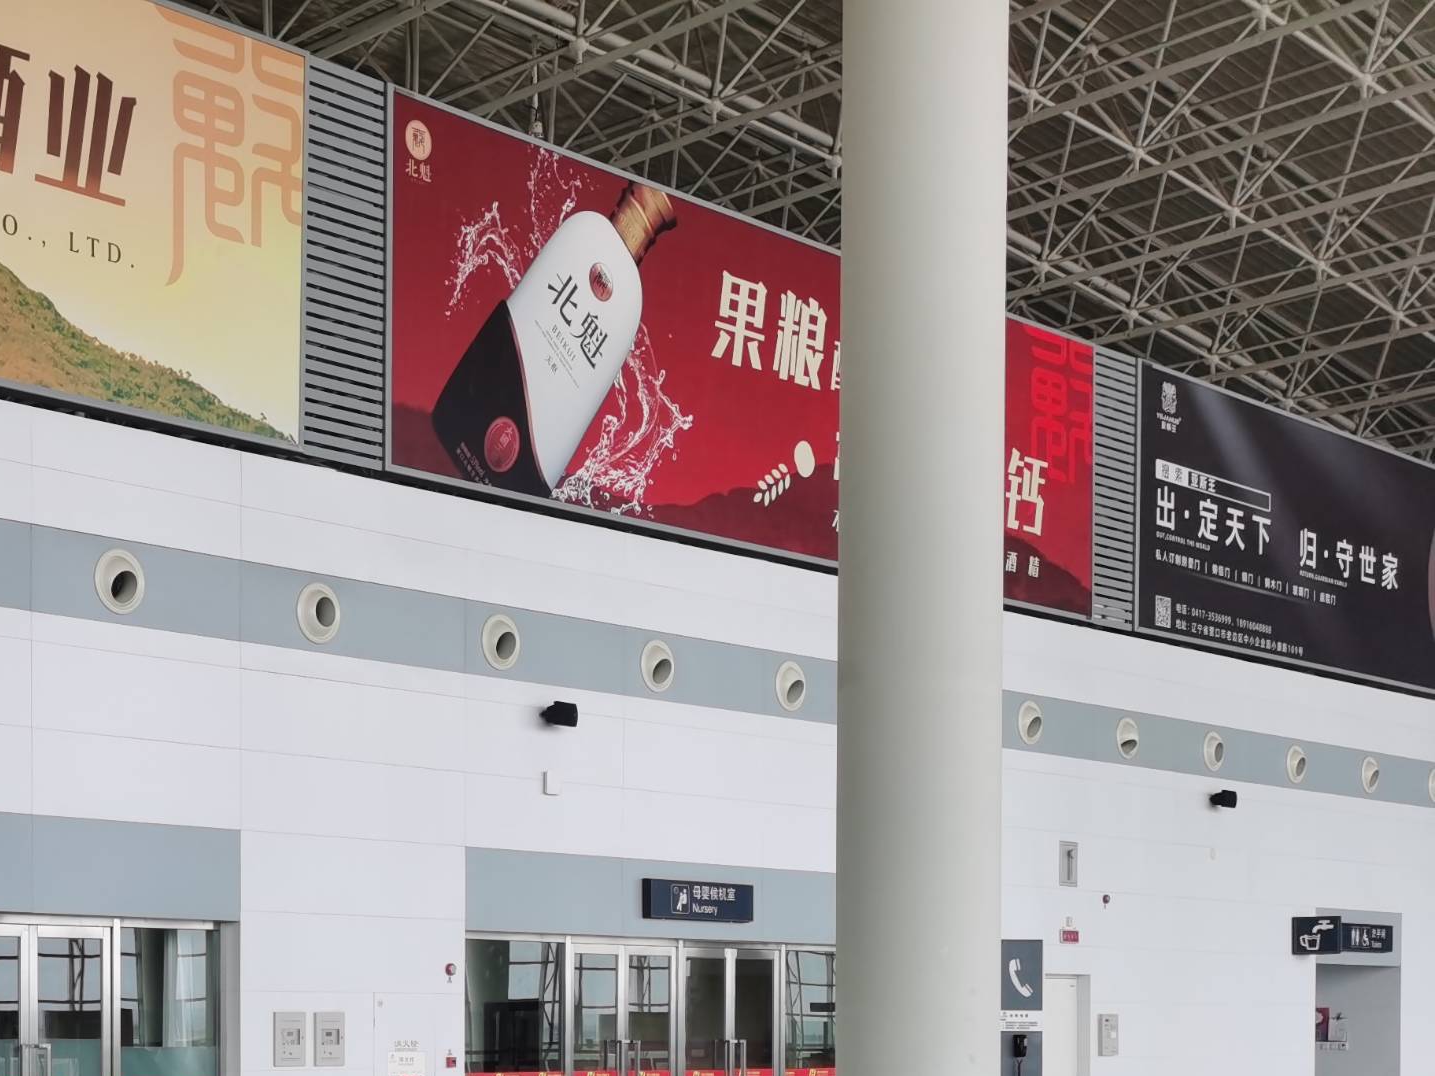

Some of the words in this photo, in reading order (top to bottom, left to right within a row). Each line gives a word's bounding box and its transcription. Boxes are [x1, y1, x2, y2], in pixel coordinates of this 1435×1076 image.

[69, 231, 136, 269] LTD.
[1005, 447, 1049, 537] 钙
[692, 885, 736, 901] 母婴候机室
[692, 903, 718, 916] Nursery
